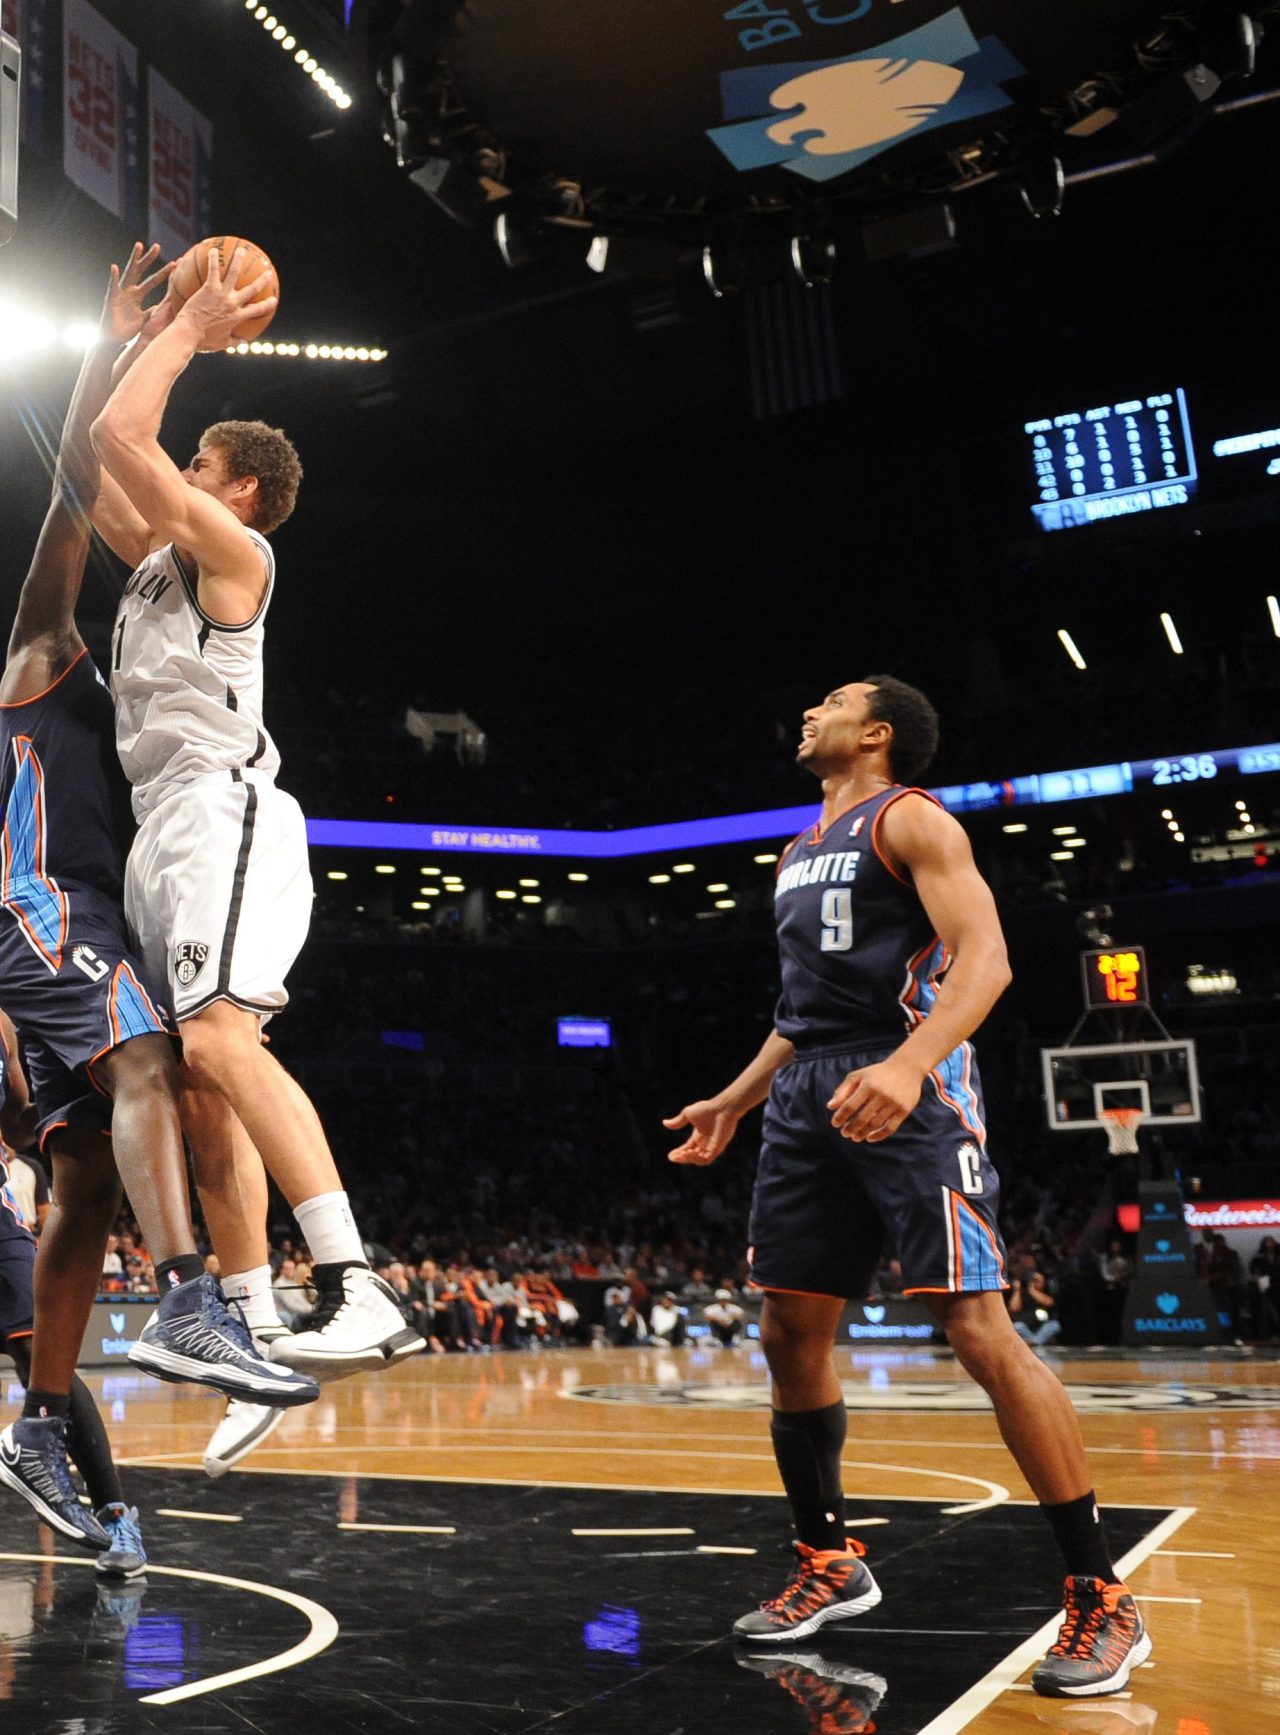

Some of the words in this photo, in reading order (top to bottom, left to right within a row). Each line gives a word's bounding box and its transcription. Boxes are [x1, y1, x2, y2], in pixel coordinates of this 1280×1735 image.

[1152, 754, 1218, 786] 2:36
[431, 830, 469, 846] STAY
[470, 832, 541, 849] HEALTHY.
[821, 888, 853, 952] 9
[176, 943, 207, 962] NETS
[1105, 972, 1137, 1001] 12
[1135, 1318, 1207, 1333] BARCLAYS
